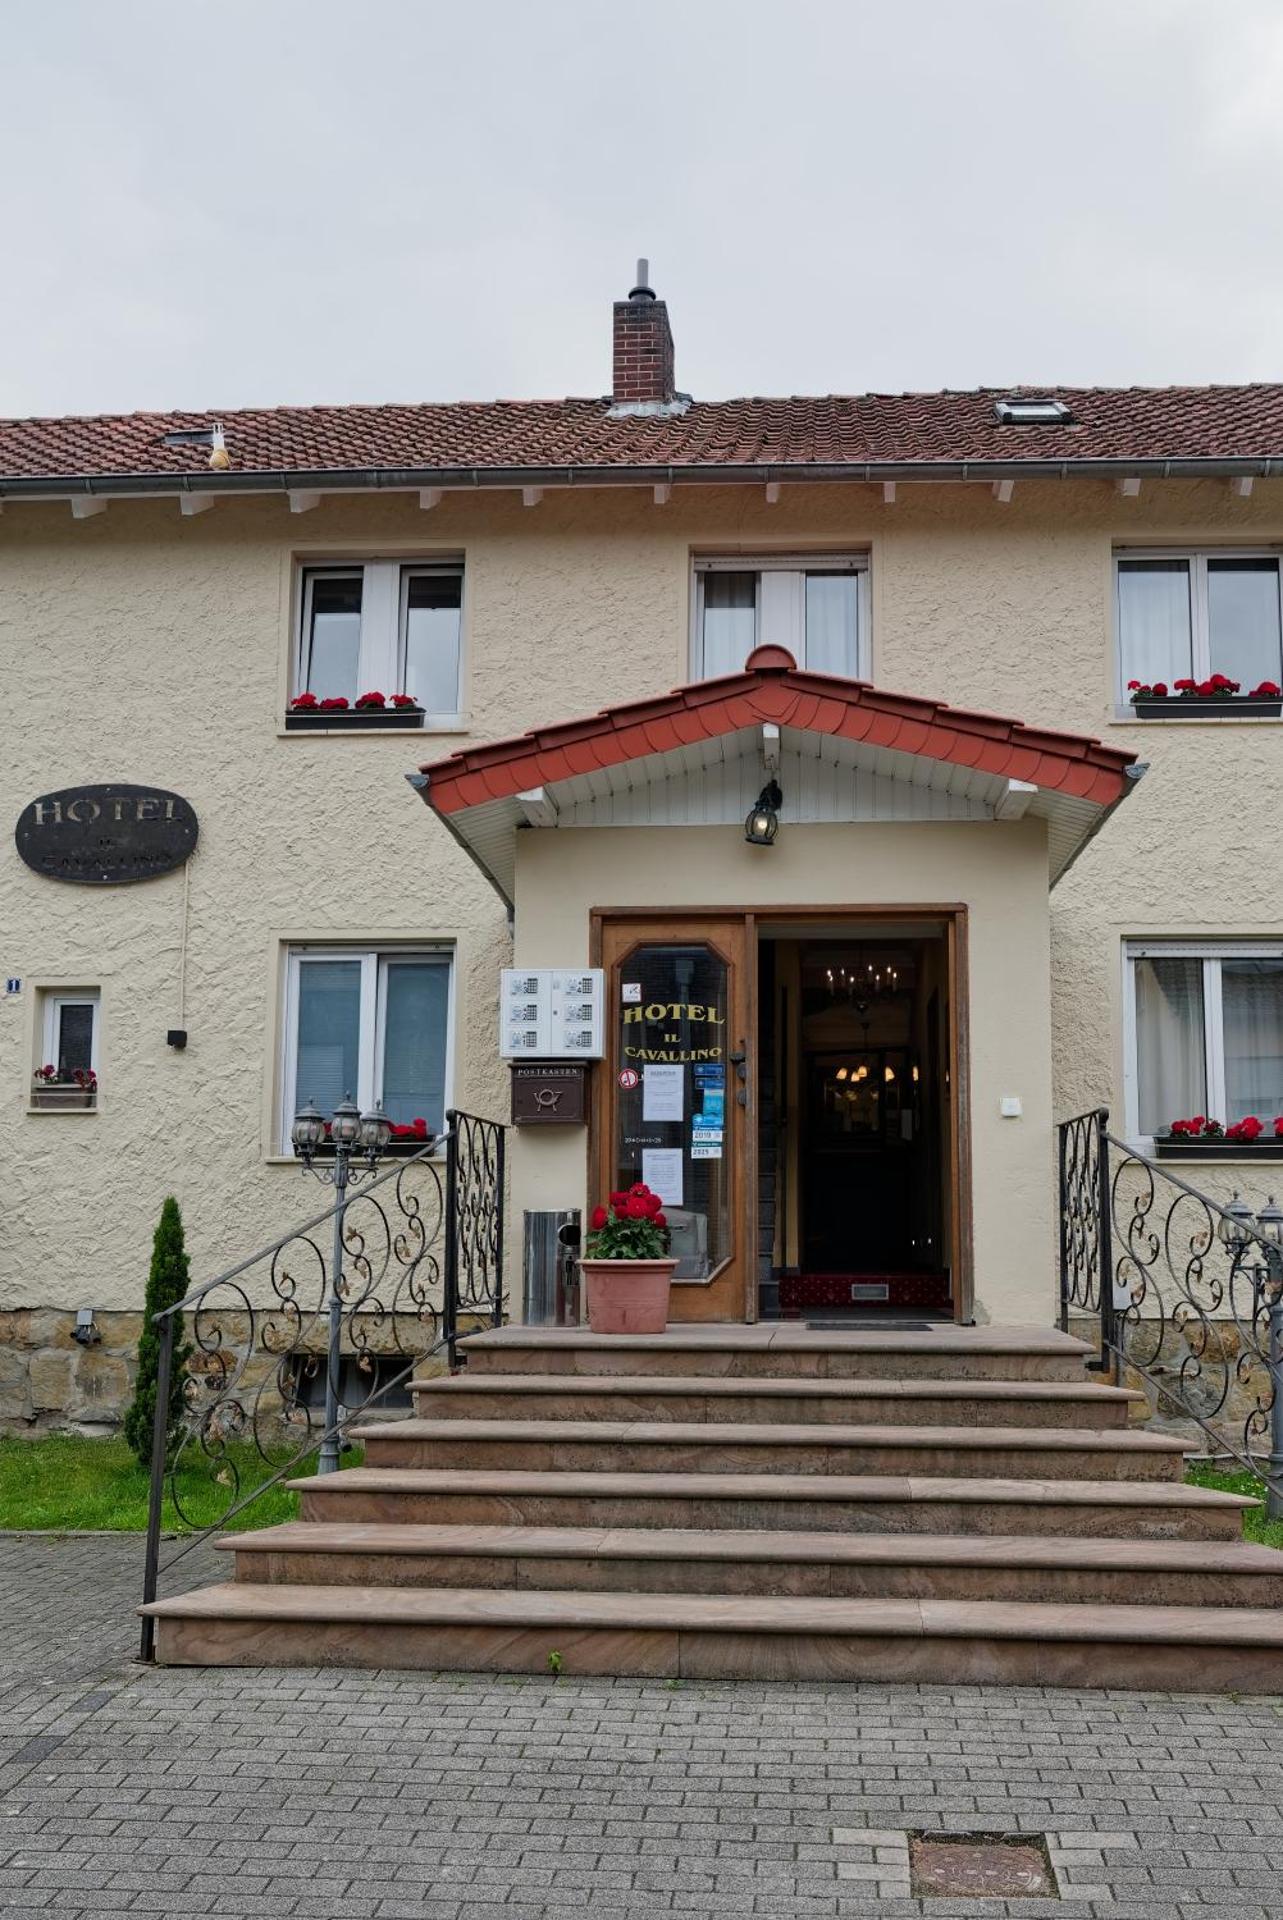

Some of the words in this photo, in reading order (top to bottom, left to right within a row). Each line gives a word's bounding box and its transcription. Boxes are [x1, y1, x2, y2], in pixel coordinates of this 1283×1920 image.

[33, 798, 183, 825] HOTEL
[623, 1003, 725, 1025] HOTEL
[664, 1033, 680, 1043] IL
[624, 1046, 722, 1061] CAVALLINO
[518, 1068, 578, 1077] POSTKASTEN
